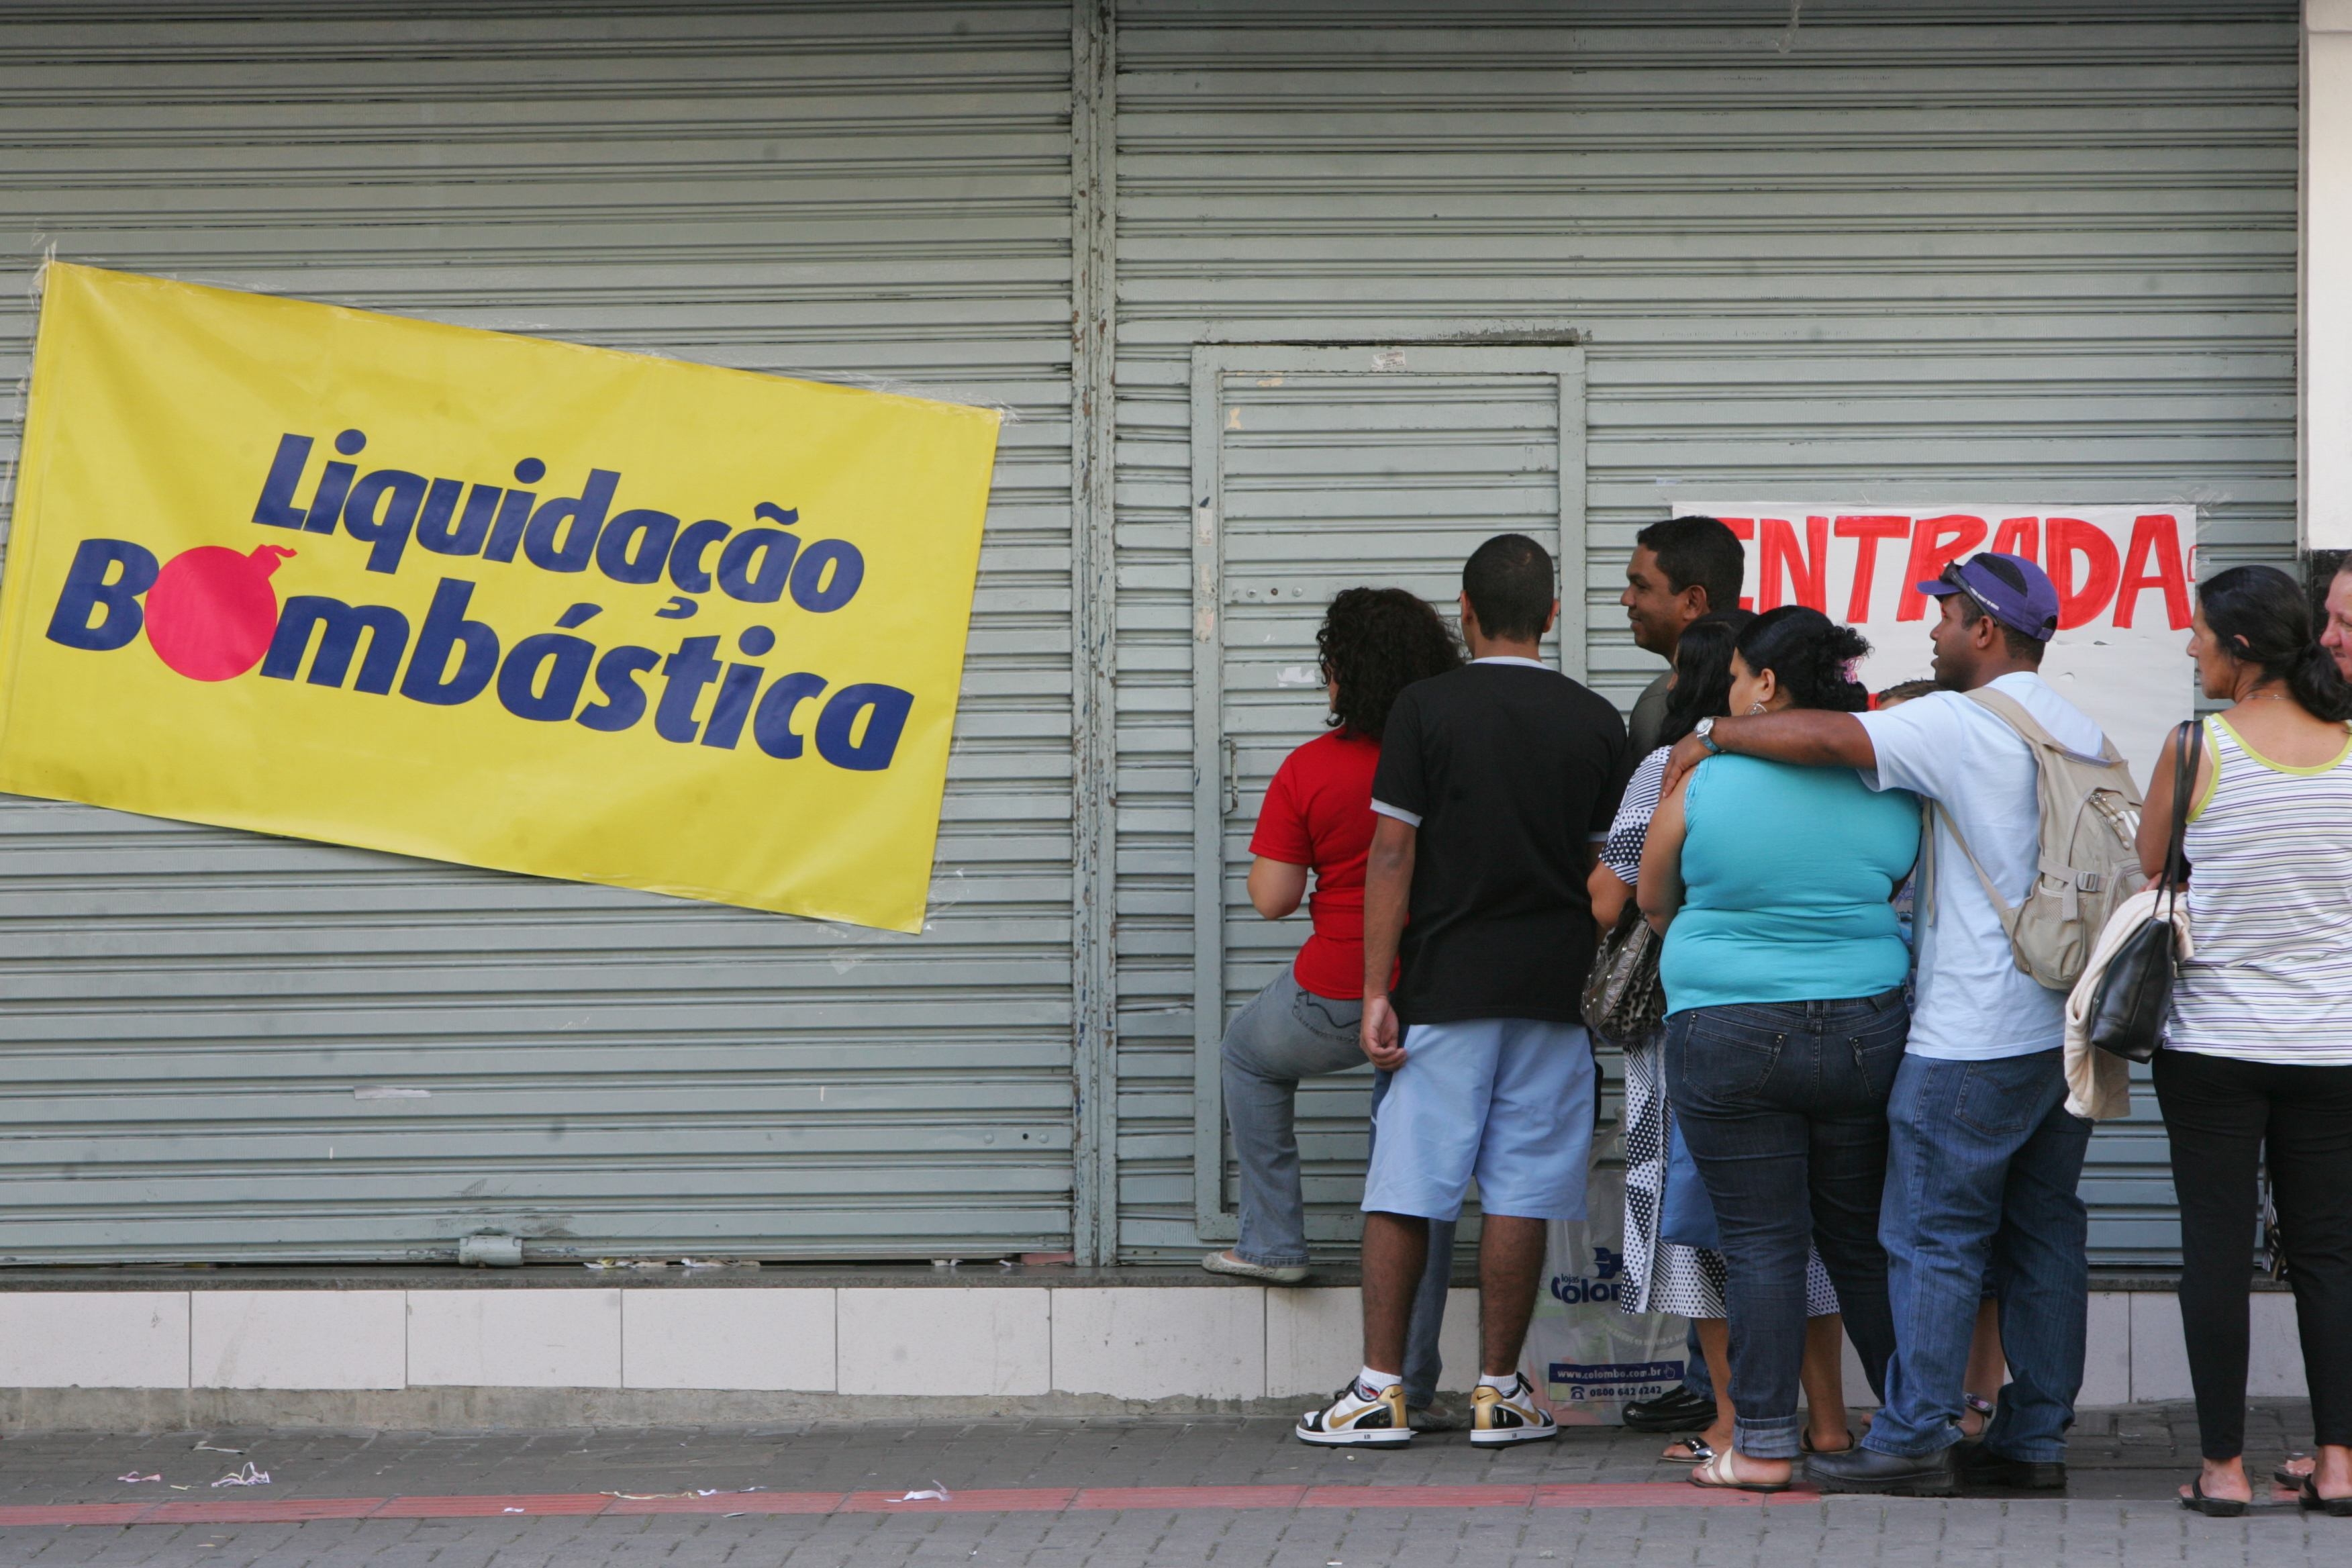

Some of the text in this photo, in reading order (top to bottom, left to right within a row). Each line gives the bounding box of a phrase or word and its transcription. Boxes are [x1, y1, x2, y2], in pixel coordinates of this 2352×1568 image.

[251, 429, 864, 620] Liquidação
[1716, 514, 2193, 631] NTRDA
[1557, 1367, 1661, 1380] www.colombo.com.br
[1589, 1385, 1661, 1397] 0800 642 4242
